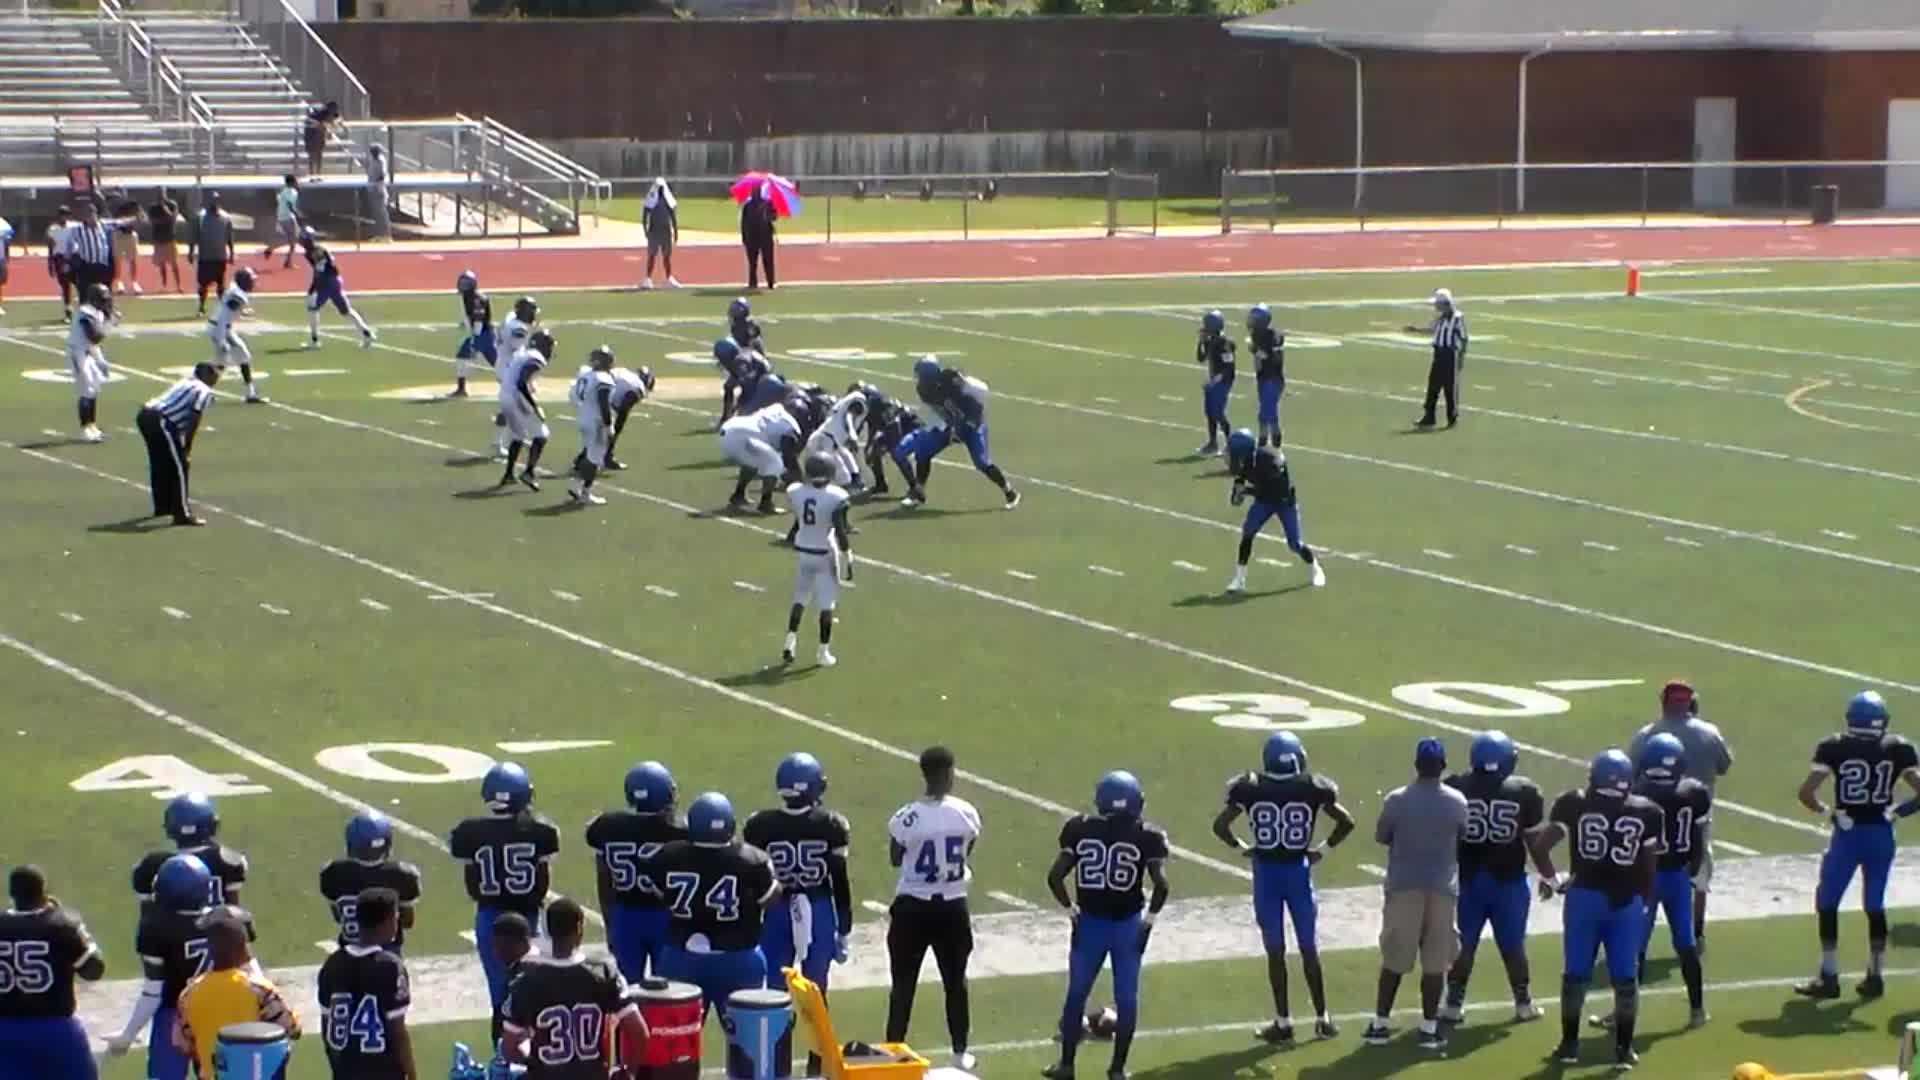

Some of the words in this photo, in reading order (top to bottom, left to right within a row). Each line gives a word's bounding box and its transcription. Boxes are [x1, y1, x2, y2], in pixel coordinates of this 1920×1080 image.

[803, 498, 816, 525] 6
[1839, 759, 1894, 804] 21
[1249, 802, 1312, 849] 88
[1578, 814, 1644, 865] 63
[475, 843, 536, 895] 15
[915, 836, 964, 882] 45
[1076, 839, 1140, 891] 26
[667, 872, 739, 920] 74
[327, 993, 386, 1053] 84
[536, 1003, 601, 1065] 30
